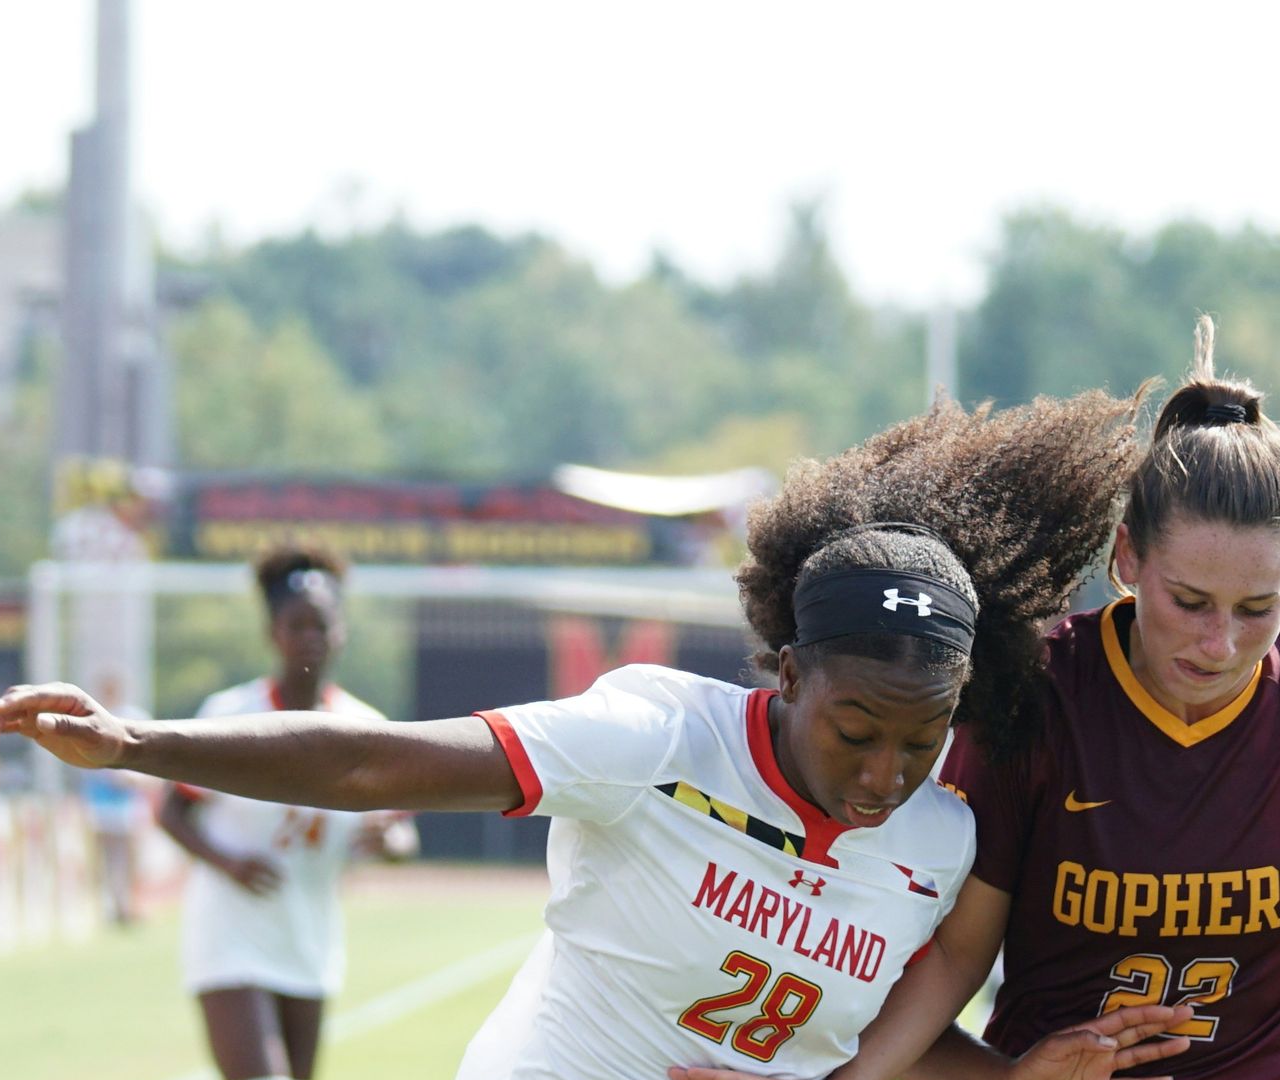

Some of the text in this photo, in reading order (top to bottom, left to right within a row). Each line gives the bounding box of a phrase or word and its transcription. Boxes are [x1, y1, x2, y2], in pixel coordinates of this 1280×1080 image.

[692, 861, 887, 983] MARYLAND
[677, 950, 823, 1063] 28
[1097, 954, 1239, 1042] 22
